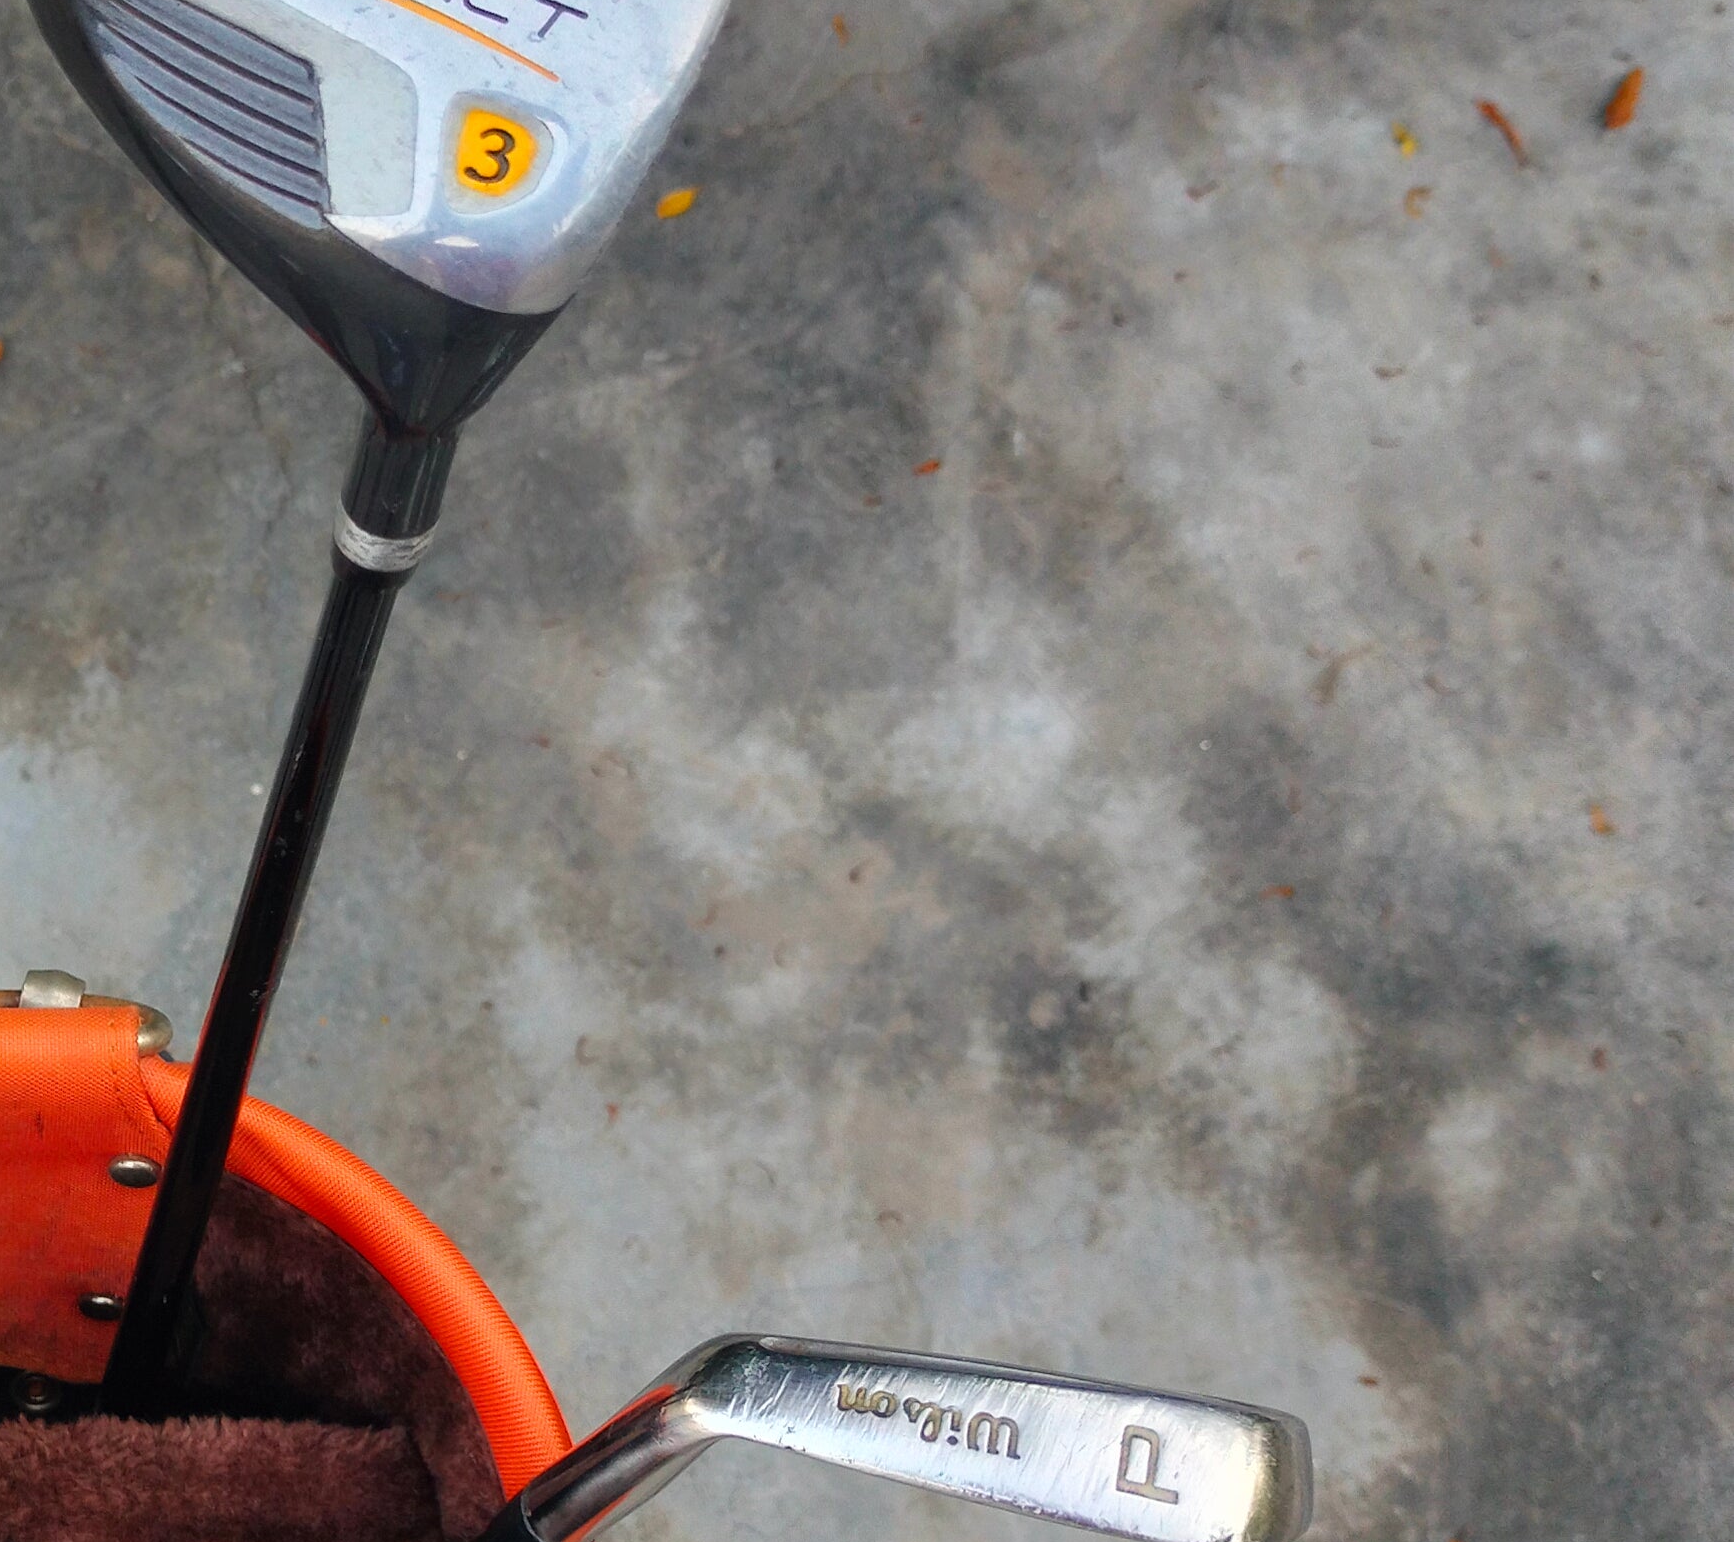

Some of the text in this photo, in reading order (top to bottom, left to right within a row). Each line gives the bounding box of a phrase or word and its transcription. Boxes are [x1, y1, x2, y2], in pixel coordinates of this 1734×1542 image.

[464, 127, 516, 184] 3
[835, 1381, 1020, 1461] Wilson
[1115, 1423, 1180, 1506] P
